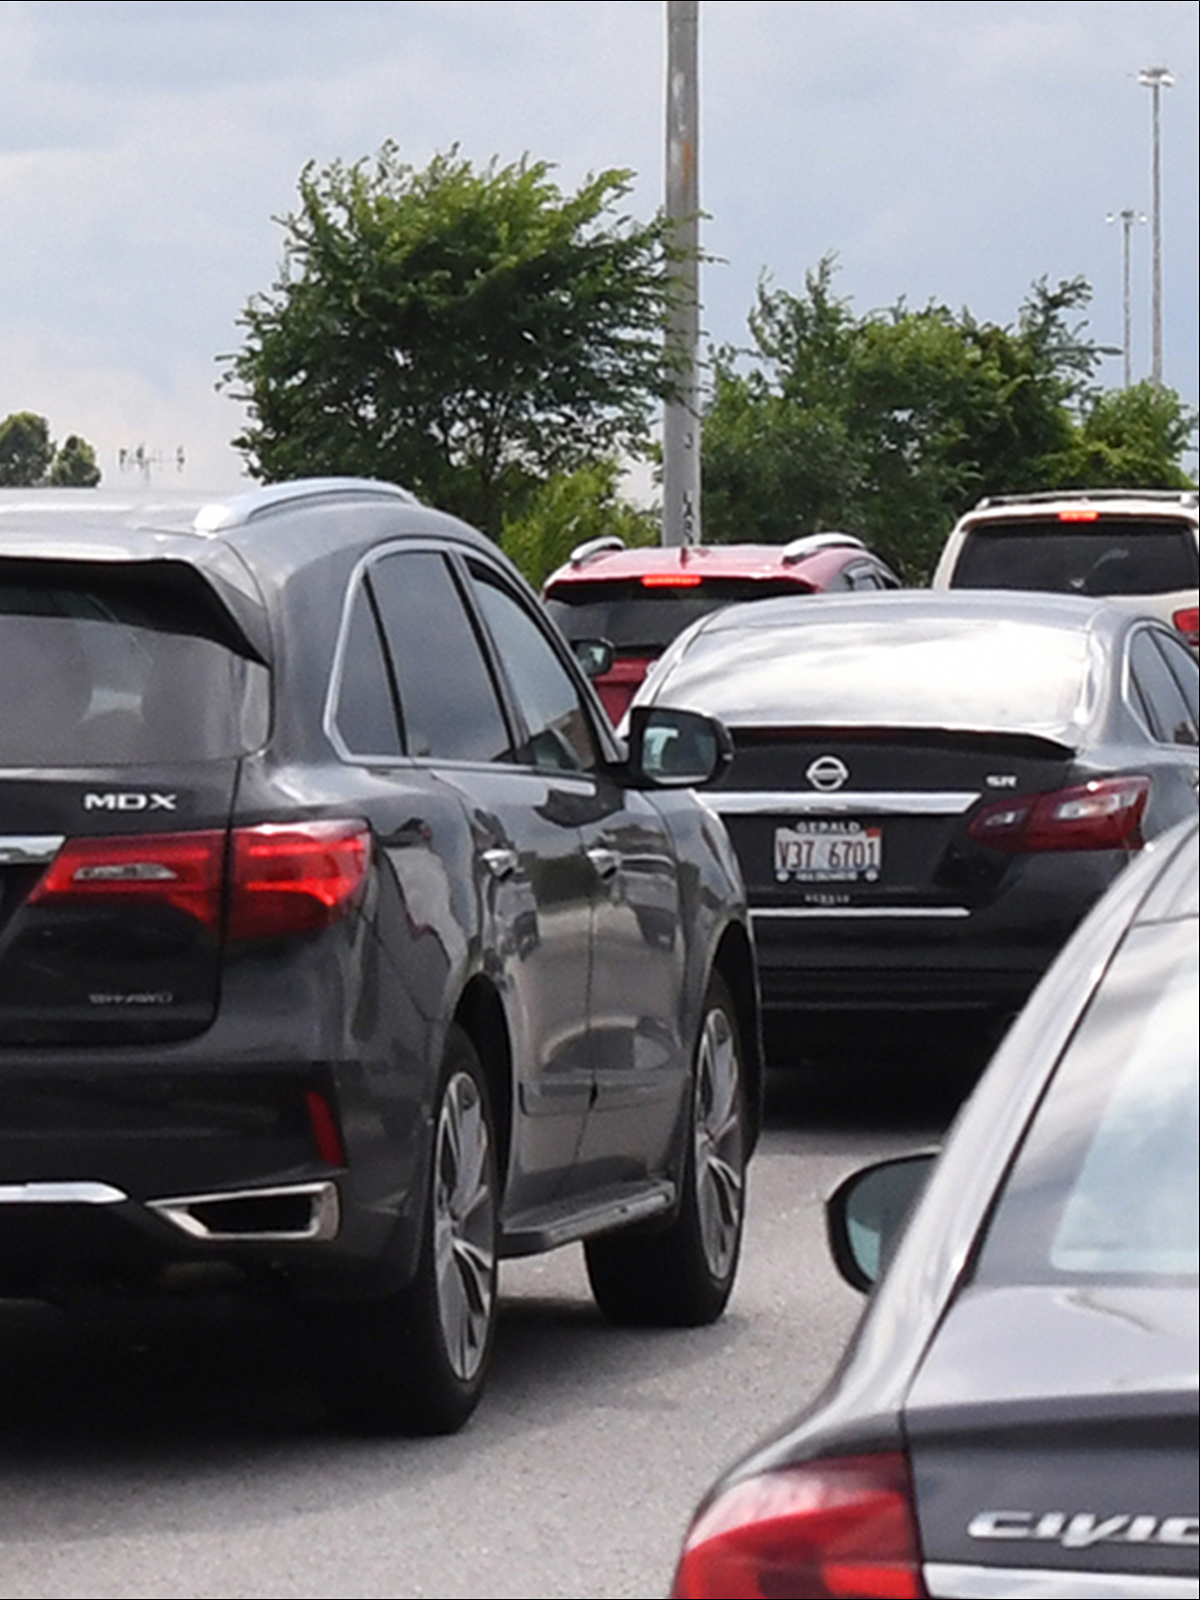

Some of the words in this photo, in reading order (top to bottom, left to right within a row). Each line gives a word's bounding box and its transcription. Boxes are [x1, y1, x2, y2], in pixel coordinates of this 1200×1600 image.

[986, 775, 1018, 788] SR
[84, 793, 177, 810] MDX
[778, 840, 815, 869] V37
[828, 840, 876, 869] 6701
[968, 1511, 1199, 1549] CIVIC
